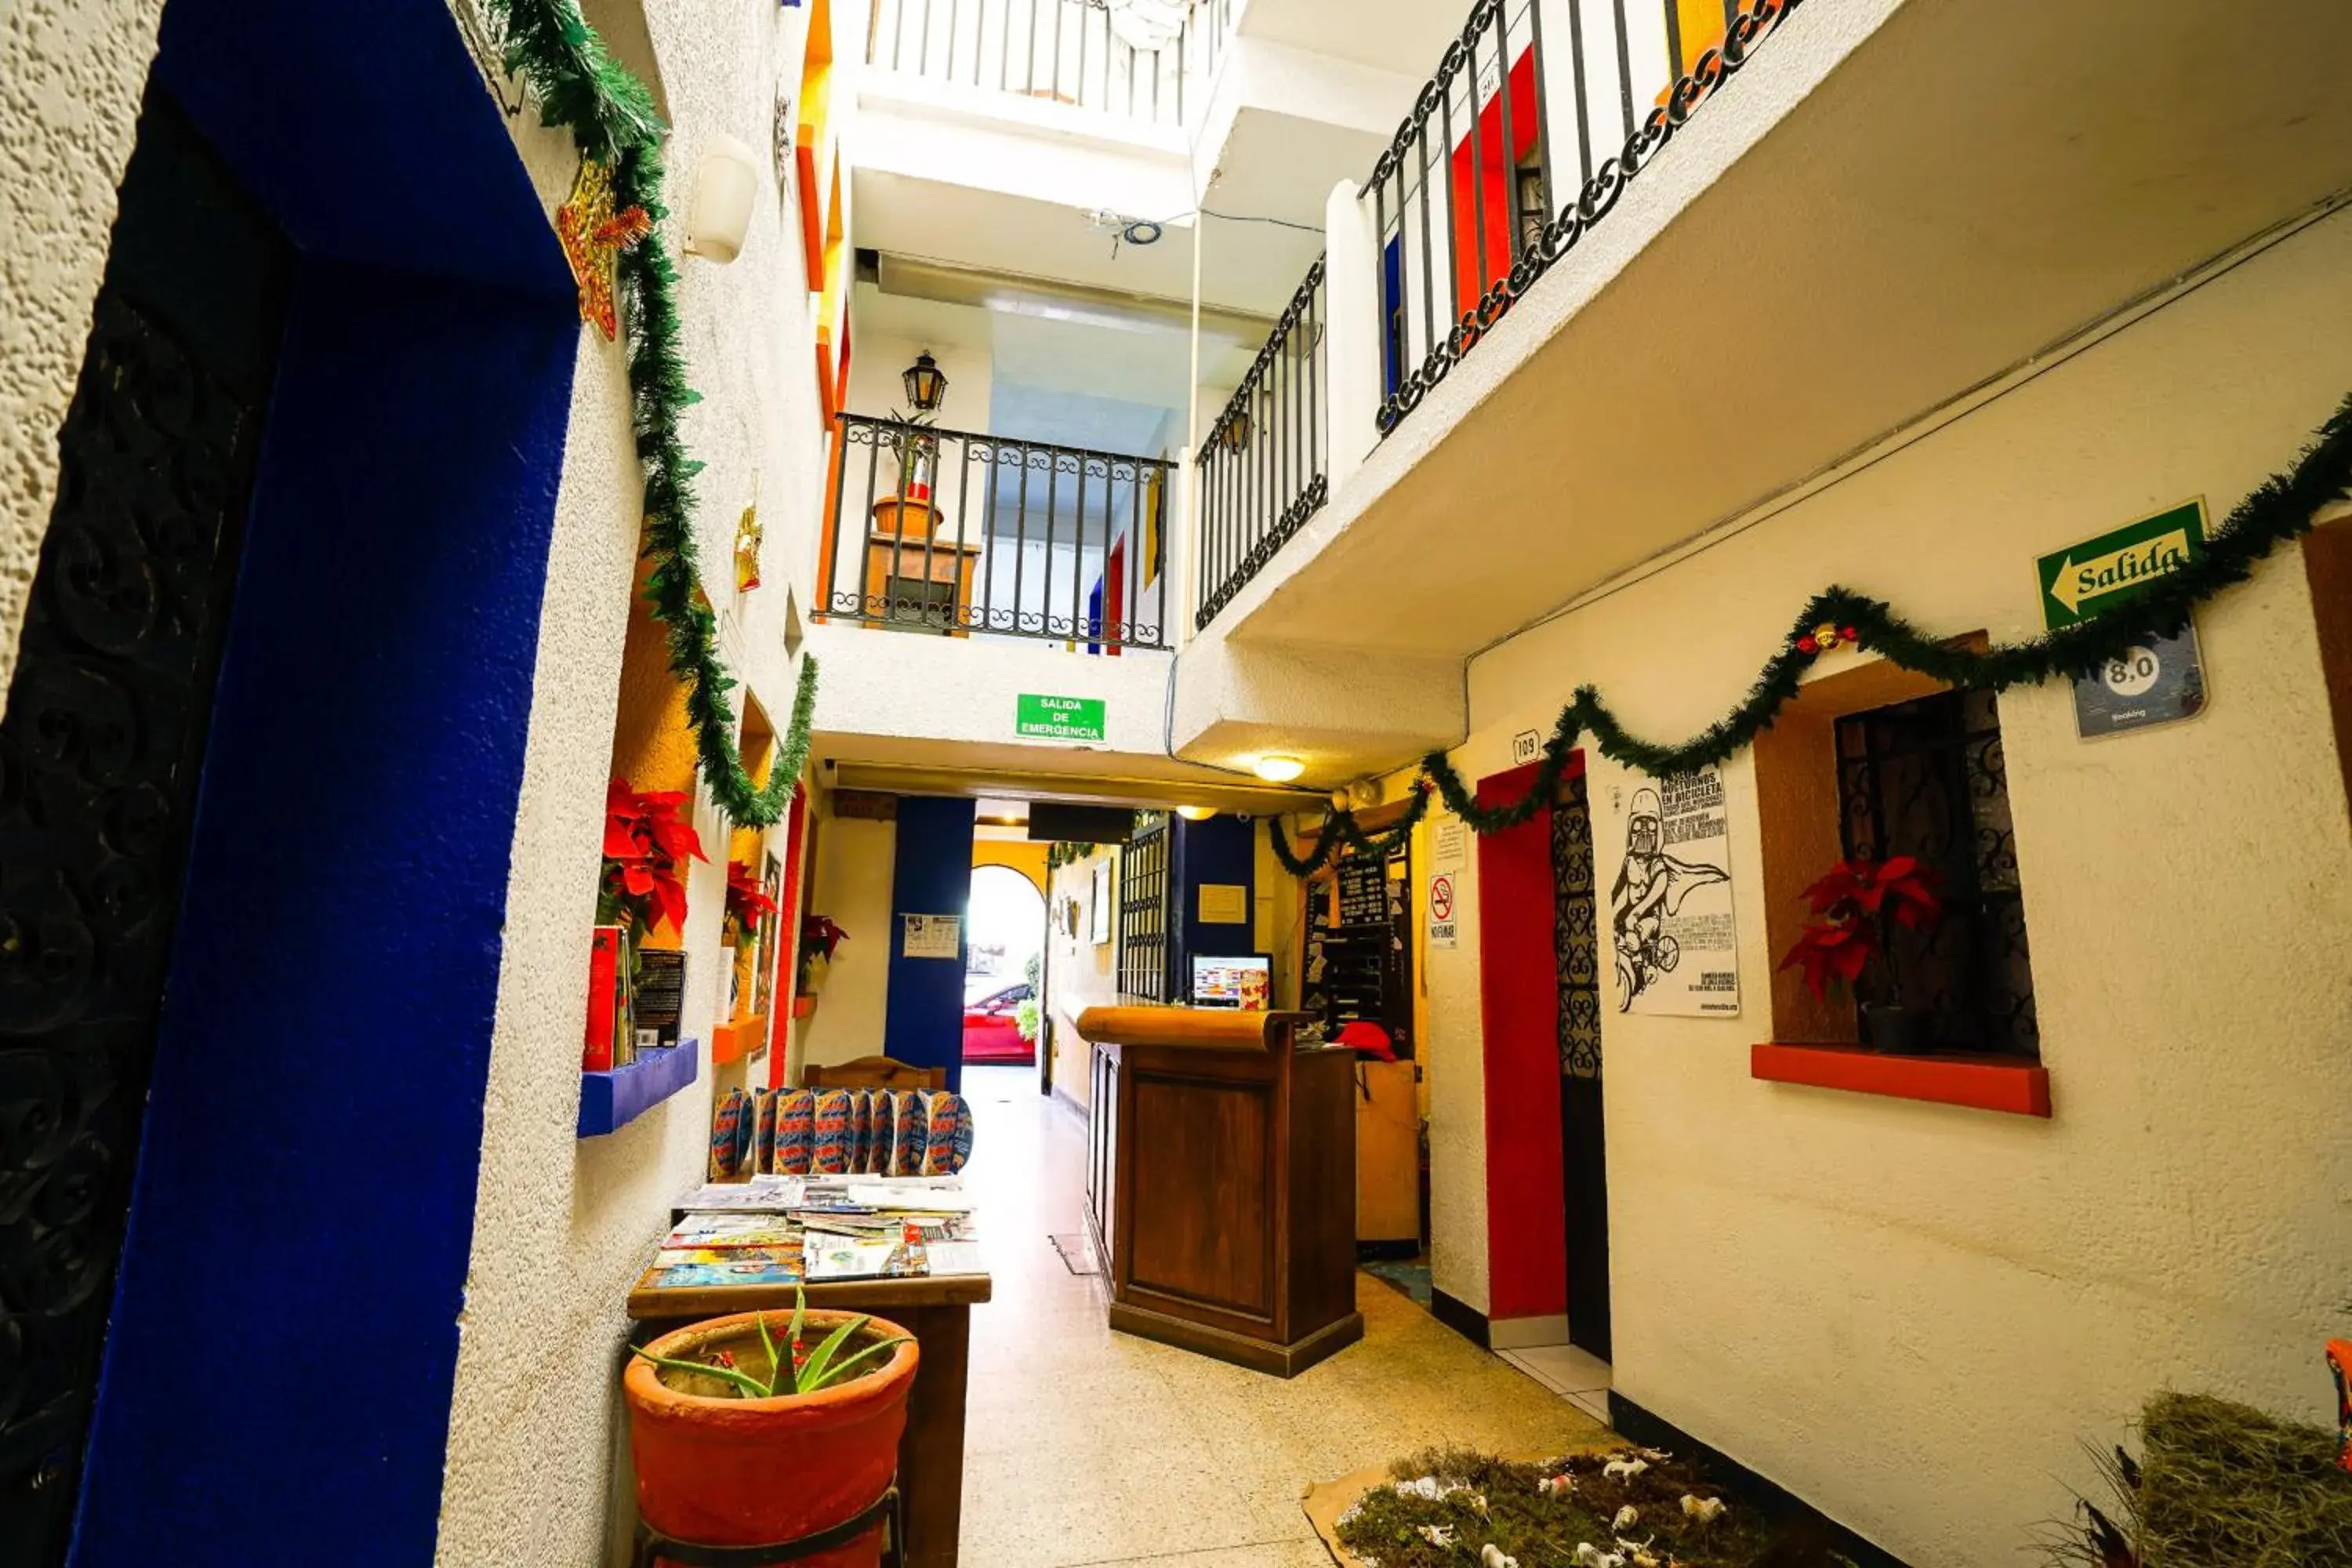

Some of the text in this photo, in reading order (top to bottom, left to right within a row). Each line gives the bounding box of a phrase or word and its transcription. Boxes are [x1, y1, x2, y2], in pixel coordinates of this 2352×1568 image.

[2078, 542, 2180, 593] Salida
[2111, 657, 2153, 684] 8,0
[1041, 699, 1081, 710] SALIDA
[1053, 713, 1069, 722] DE
[1022, 722, 1098, 738] EMERGENCIA
[1519, 738, 1534, 756] 109
[1675, 782, 1722, 803] BICICLETA
